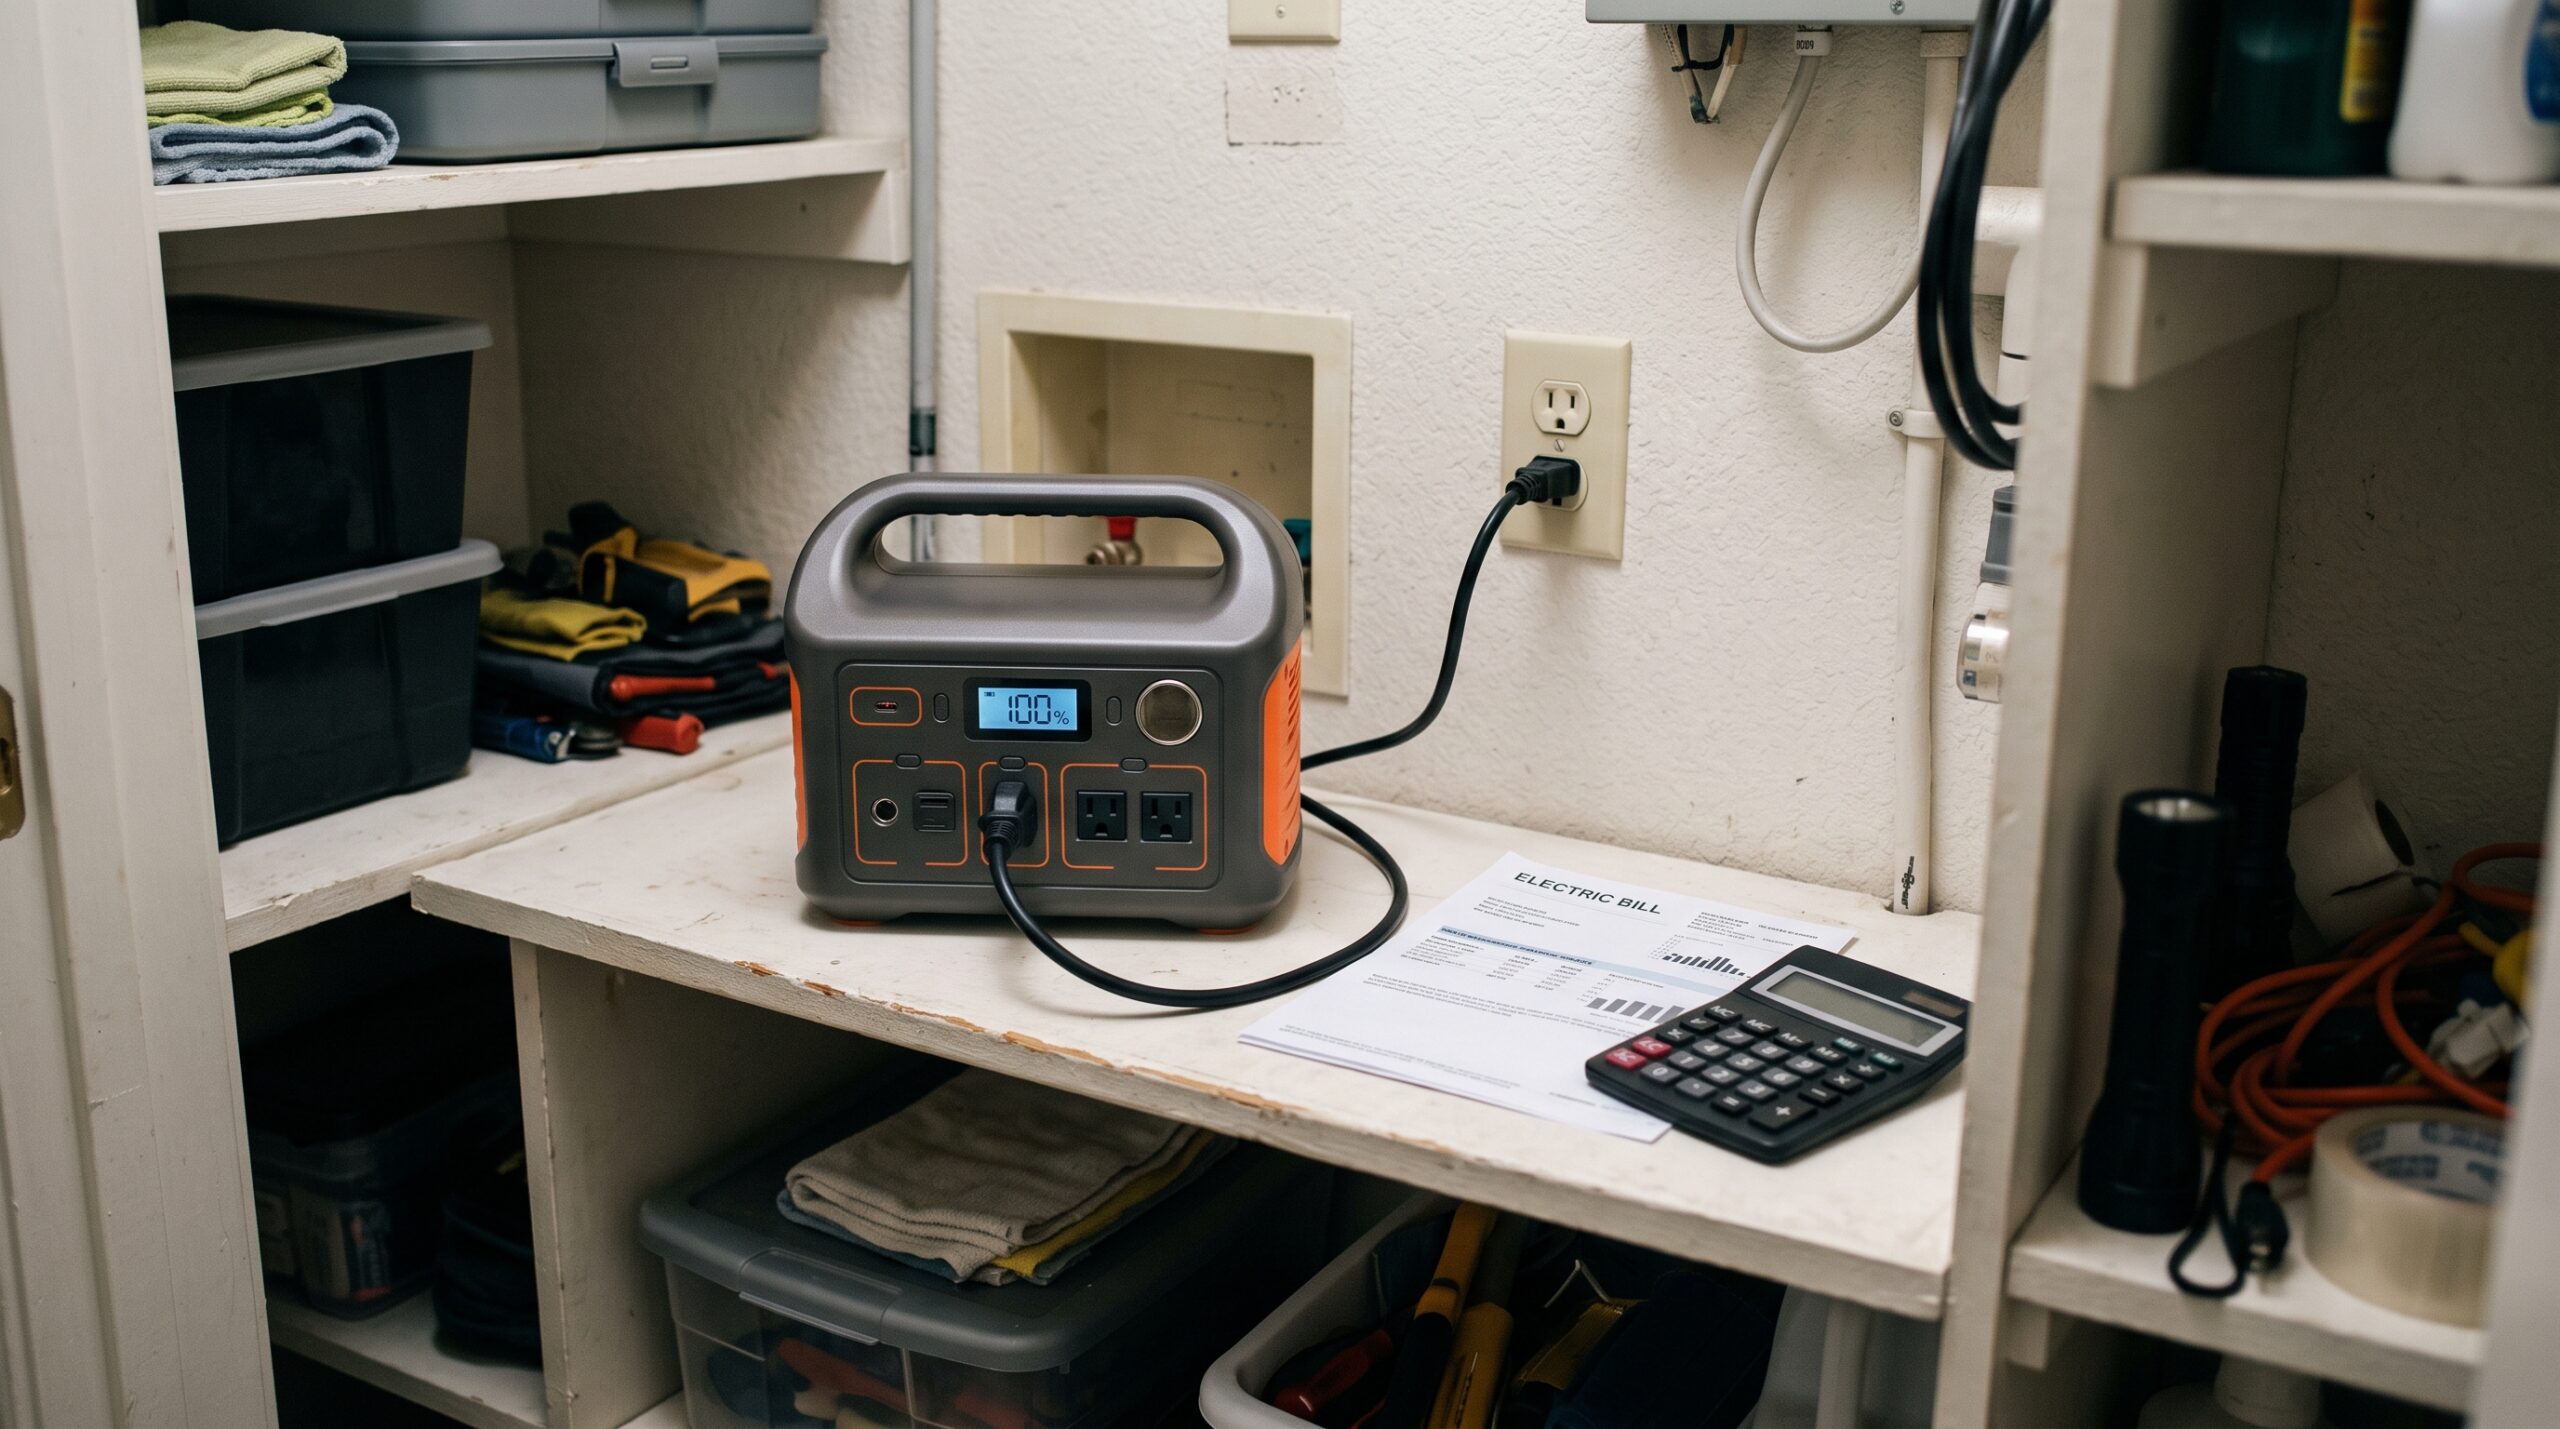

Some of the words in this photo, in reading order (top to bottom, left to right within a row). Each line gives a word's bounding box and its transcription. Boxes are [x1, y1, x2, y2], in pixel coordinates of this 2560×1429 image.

[1008, 694, 1070, 725] 100%
[1514, 871, 1615, 904] ELECTRIC
[1617, 897, 1662, 915] BILL
[1725, 1031, 1744, 1040] 7
[1679, 1056, 1695, 1065] 1
[1711, 1070, 1730, 1079] 2
